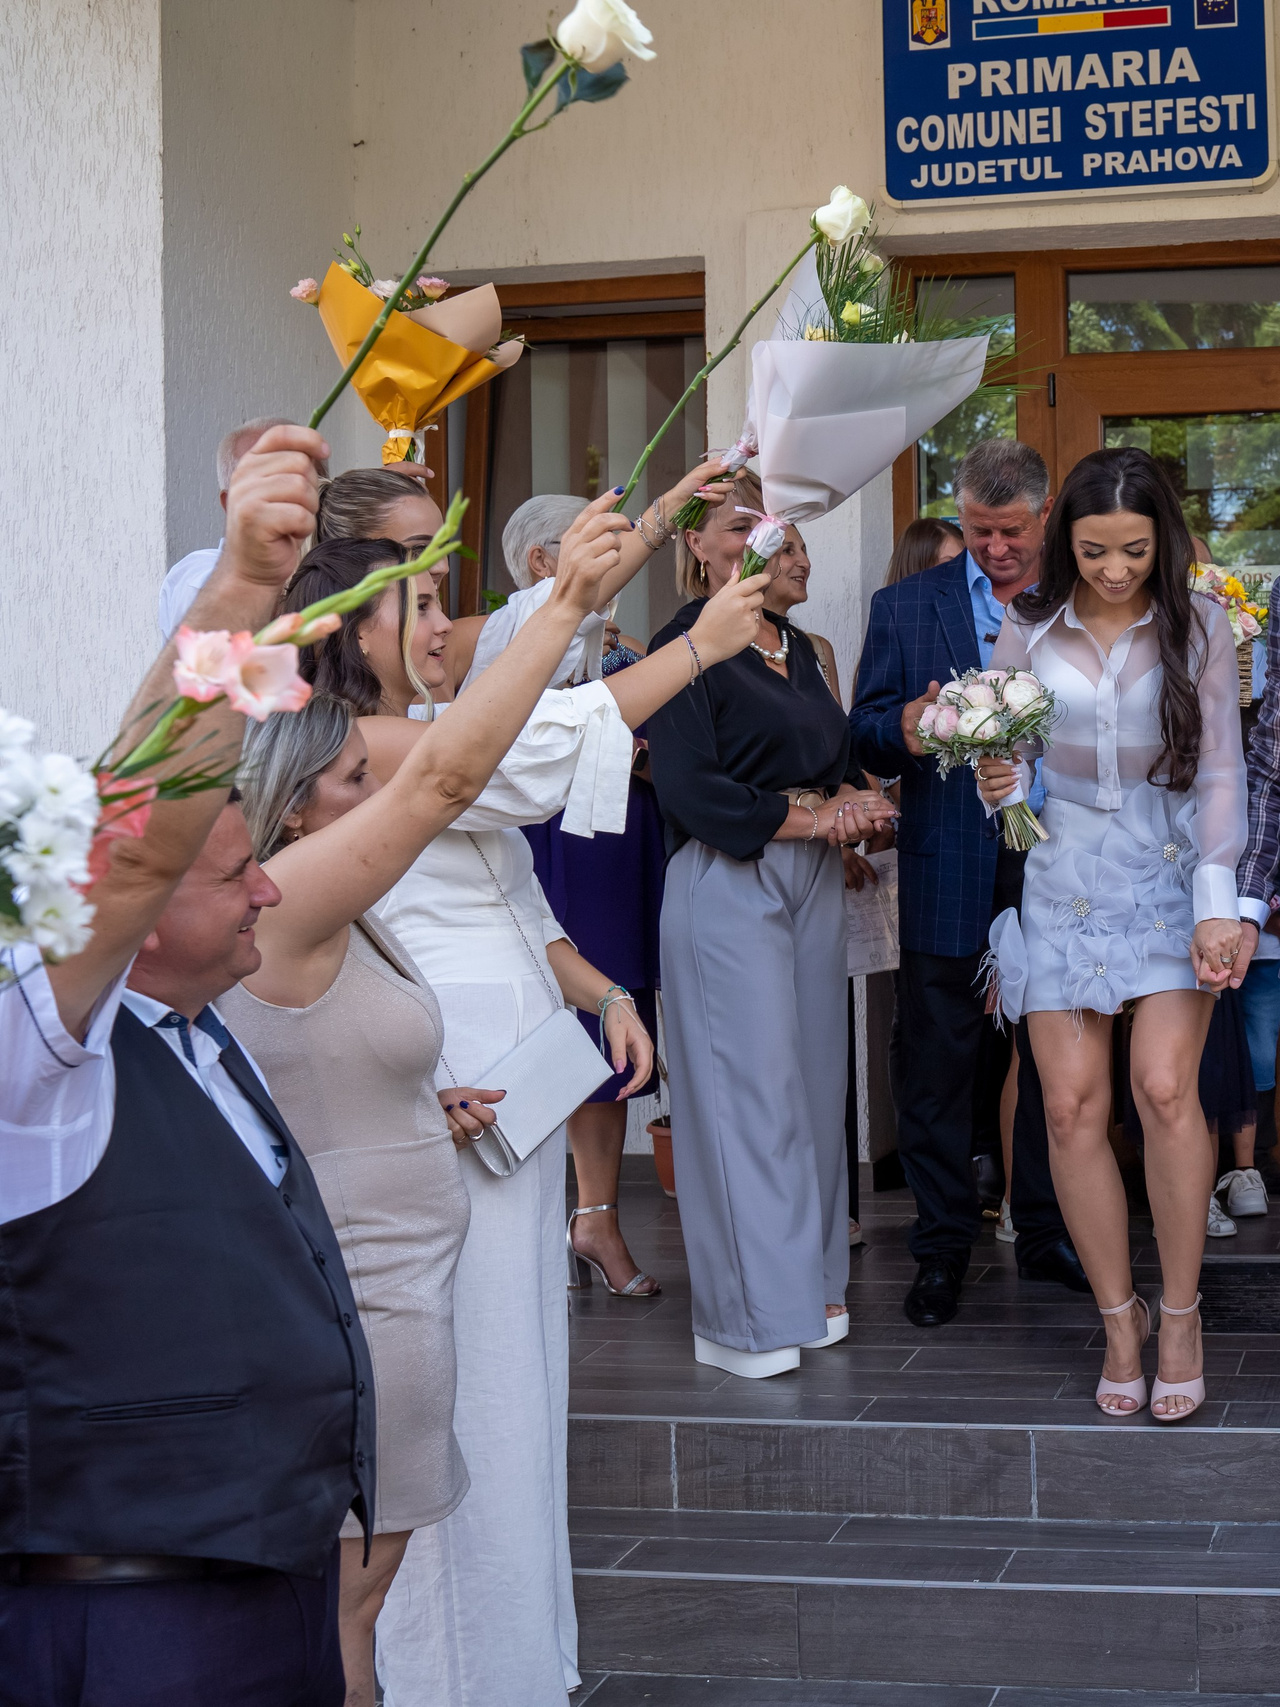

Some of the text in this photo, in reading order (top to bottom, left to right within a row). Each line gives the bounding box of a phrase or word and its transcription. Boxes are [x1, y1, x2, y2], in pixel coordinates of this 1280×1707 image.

[948, 47, 1200, 99] PRIMARIA
[897, 94, 1256, 153] COMUNEI STEFESTI
[911, 145, 1242, 188] JUDETUL PRAHOVA
